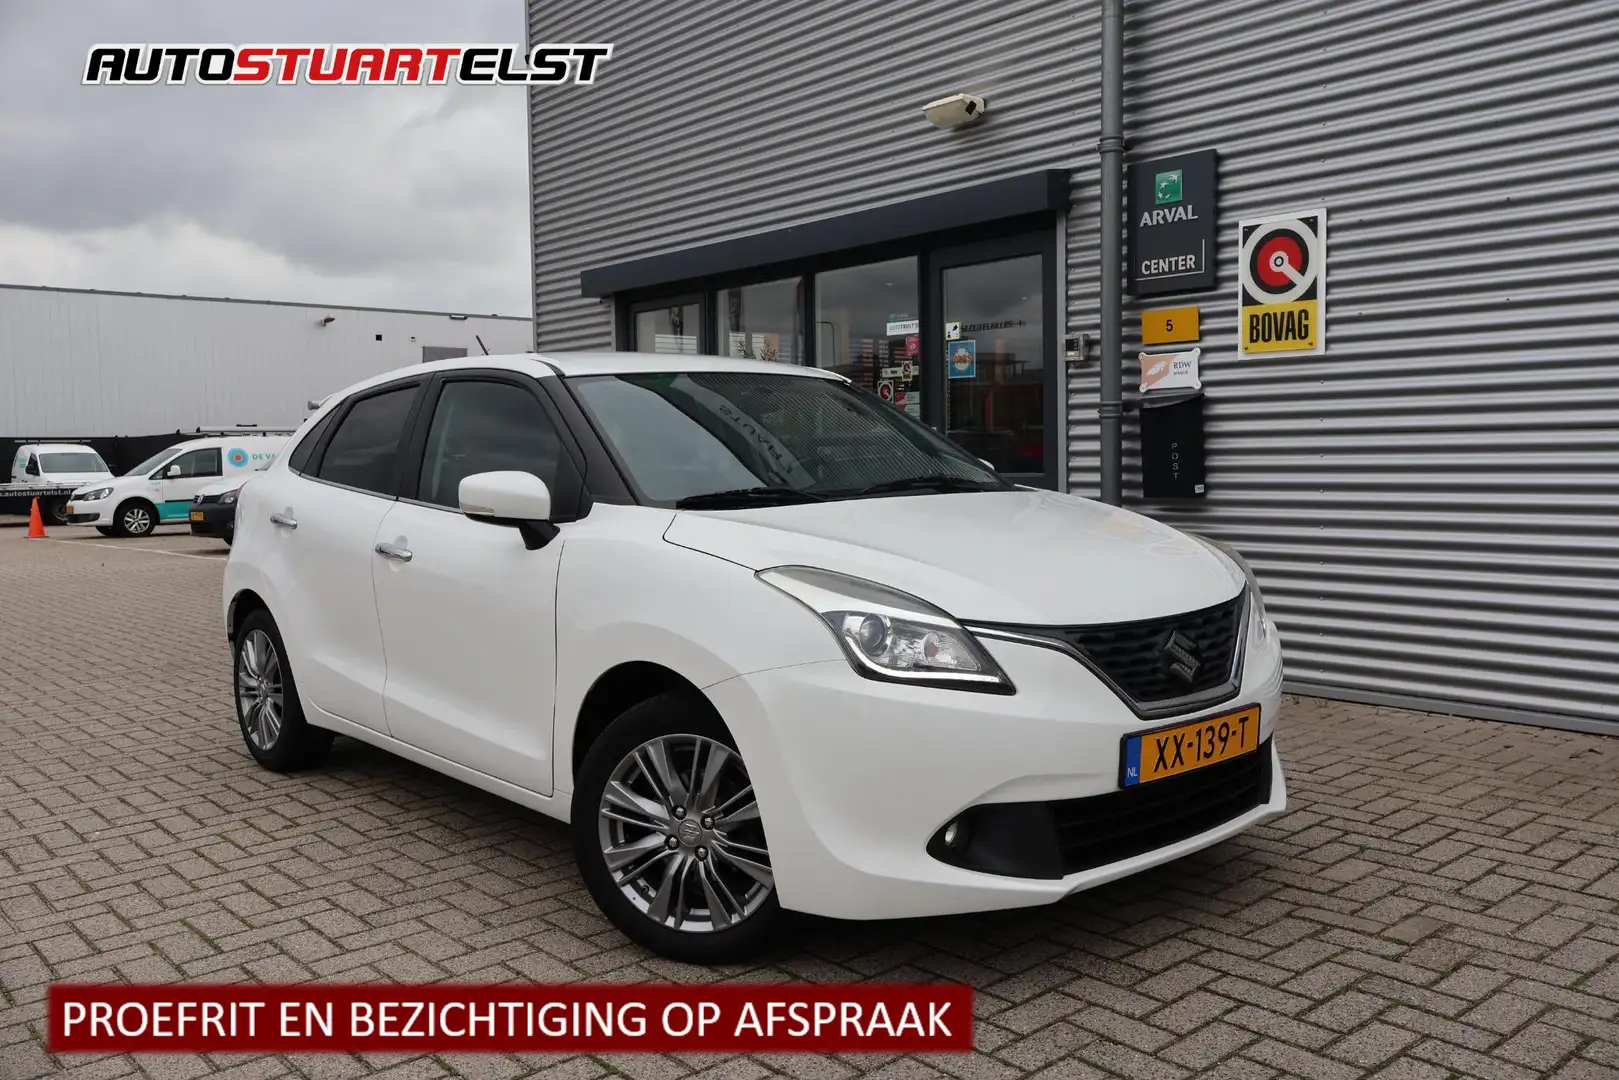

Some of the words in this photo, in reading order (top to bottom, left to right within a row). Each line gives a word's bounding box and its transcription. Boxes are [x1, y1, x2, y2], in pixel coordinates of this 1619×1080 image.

[1140, 204, 1199, 227] ARVAL
[1141, 254, 1196, 275] CENTER
[1166, 319, 1174, 332] 5
[1249, 309, 1309, 343] BOVAG
[1173, 361, 1192, 370] RDW
[1171, 442, 1180, 481] POST
[1153, 716, 1249, 773] XX-139-T
[1127, 767, 1139, 778] NL
